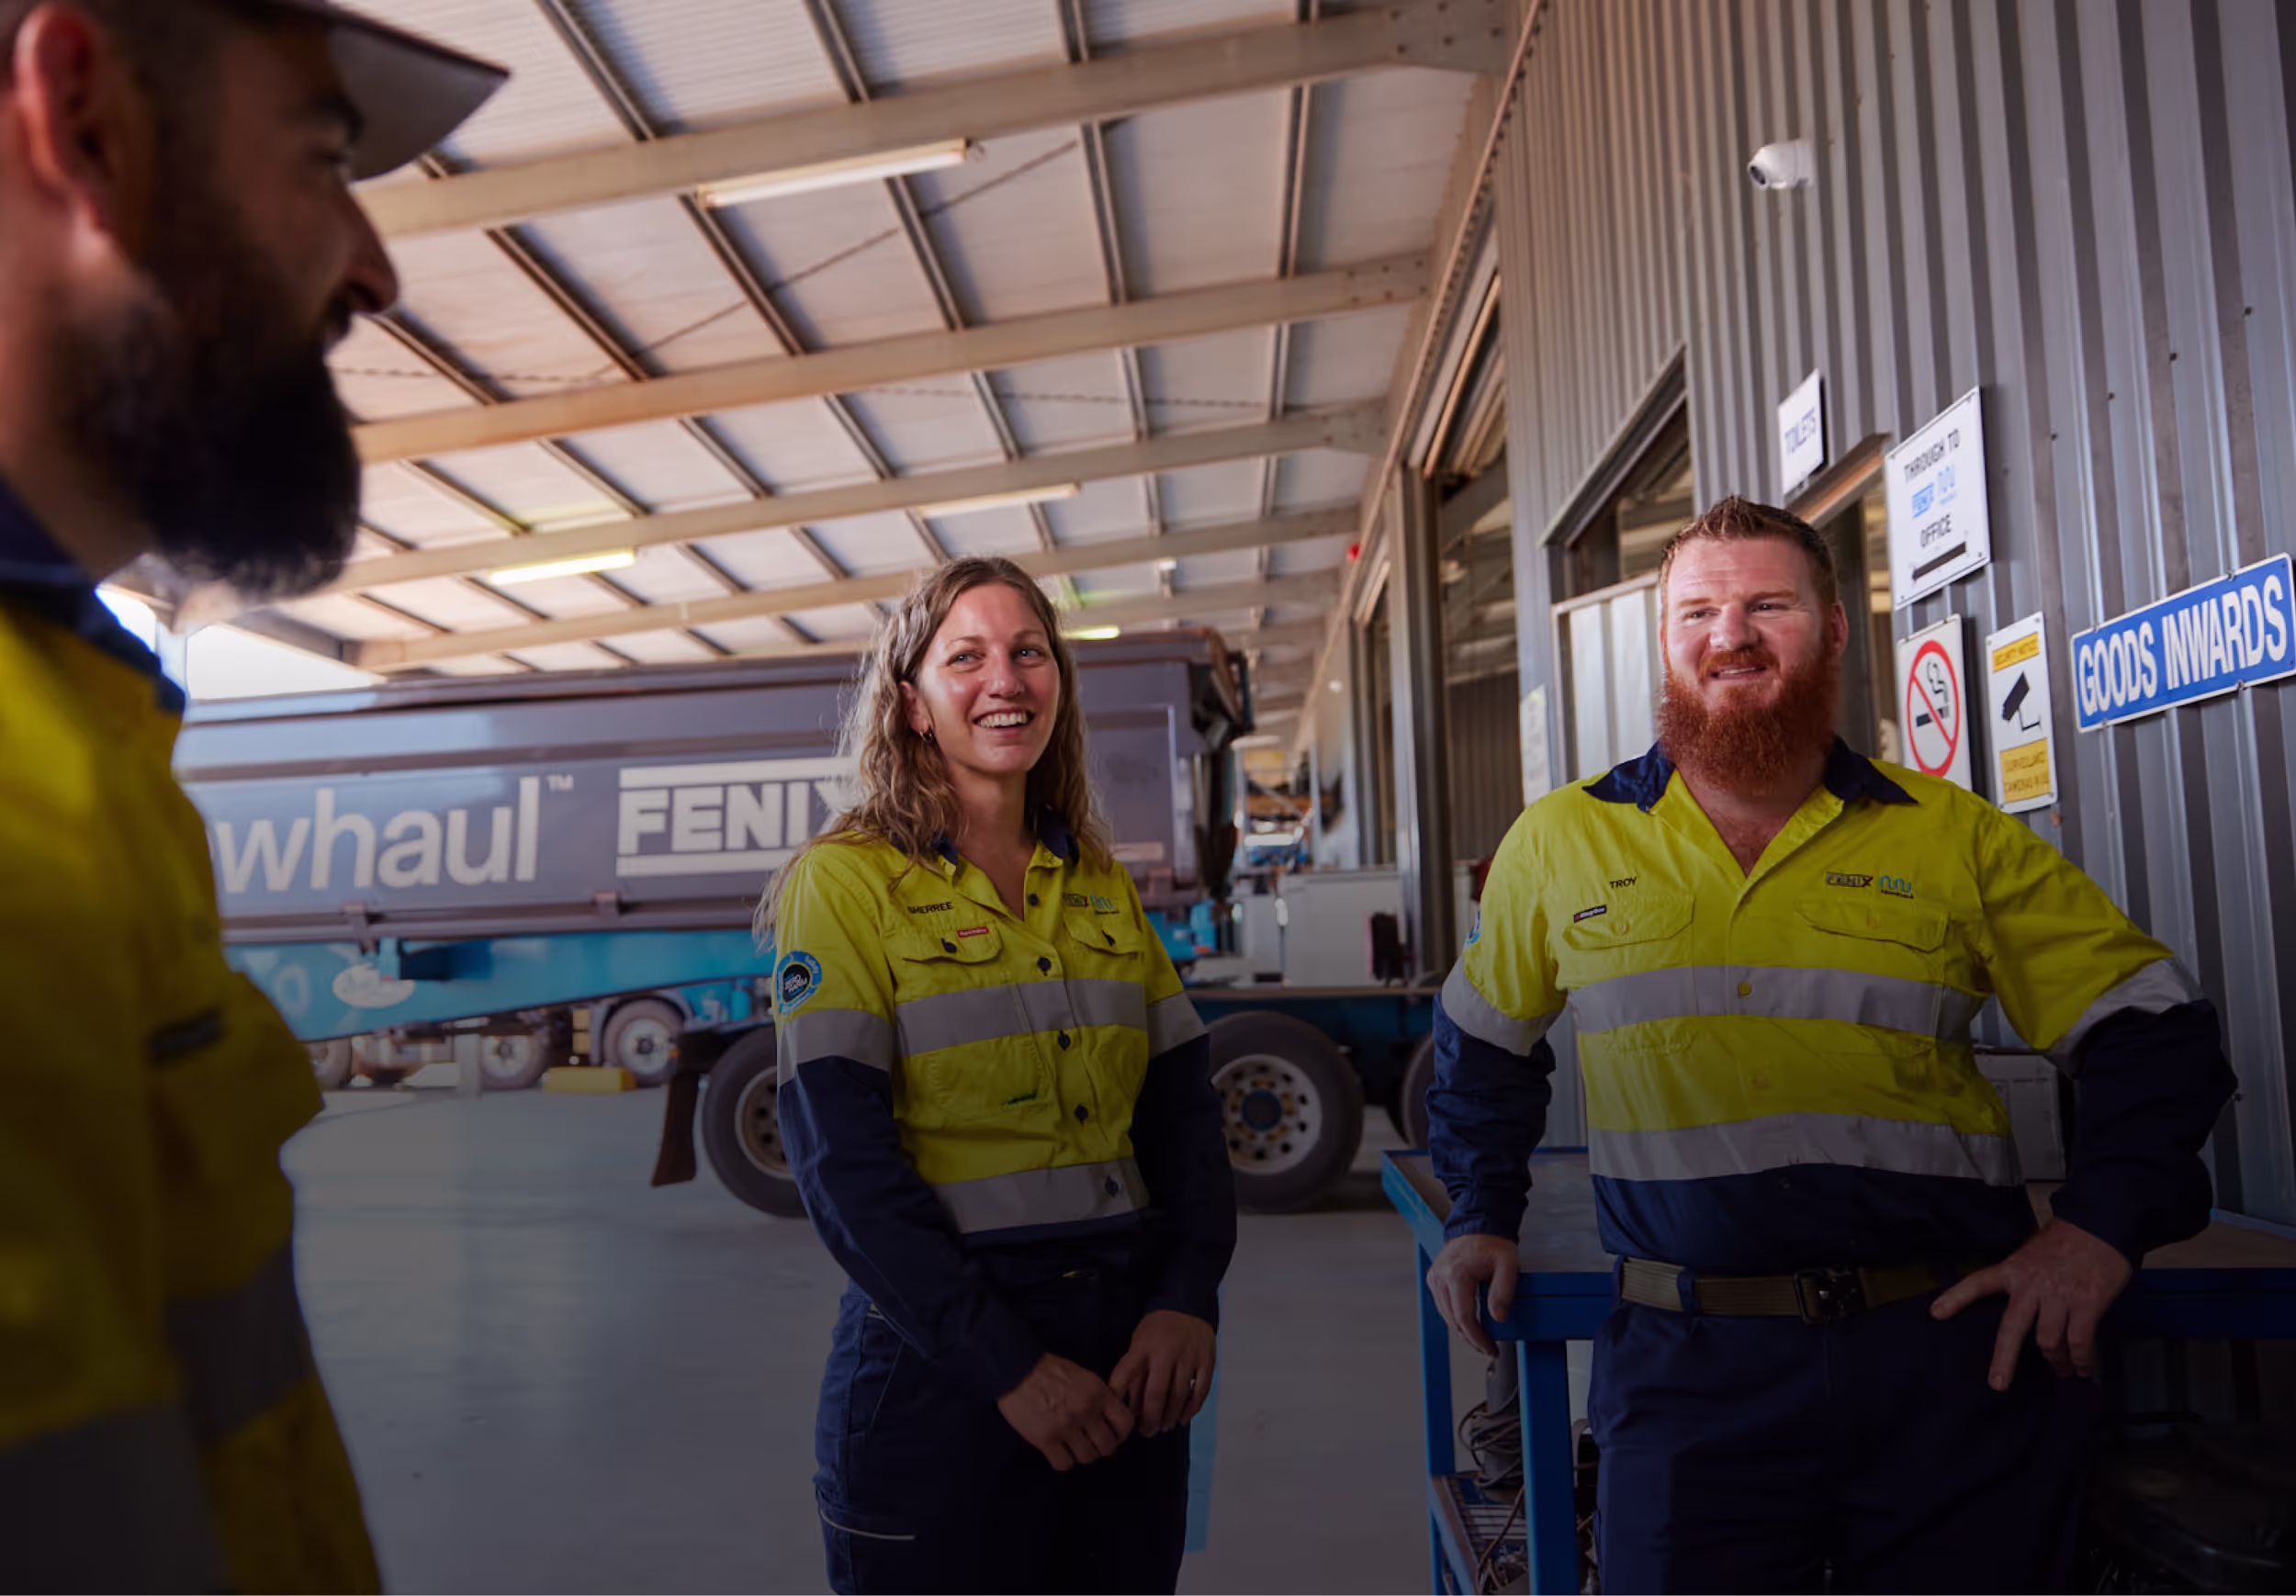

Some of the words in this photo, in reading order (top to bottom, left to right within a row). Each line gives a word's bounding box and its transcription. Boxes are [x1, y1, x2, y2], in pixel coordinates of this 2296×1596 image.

[1784, 407, 1817, 455] TOILETS
[1904, 440, 1944, 484] THROUGH
[1948, 428, 1961, 454] TO
[1919, 512, 1953, 549] OFFICE
[2078, 620, 2158, 717] GOODS
[2161, 574, 2287, 691] INWARDS
[205, 776, 540, 894] whaul
[1609, 876, 1638, 889] TROY
